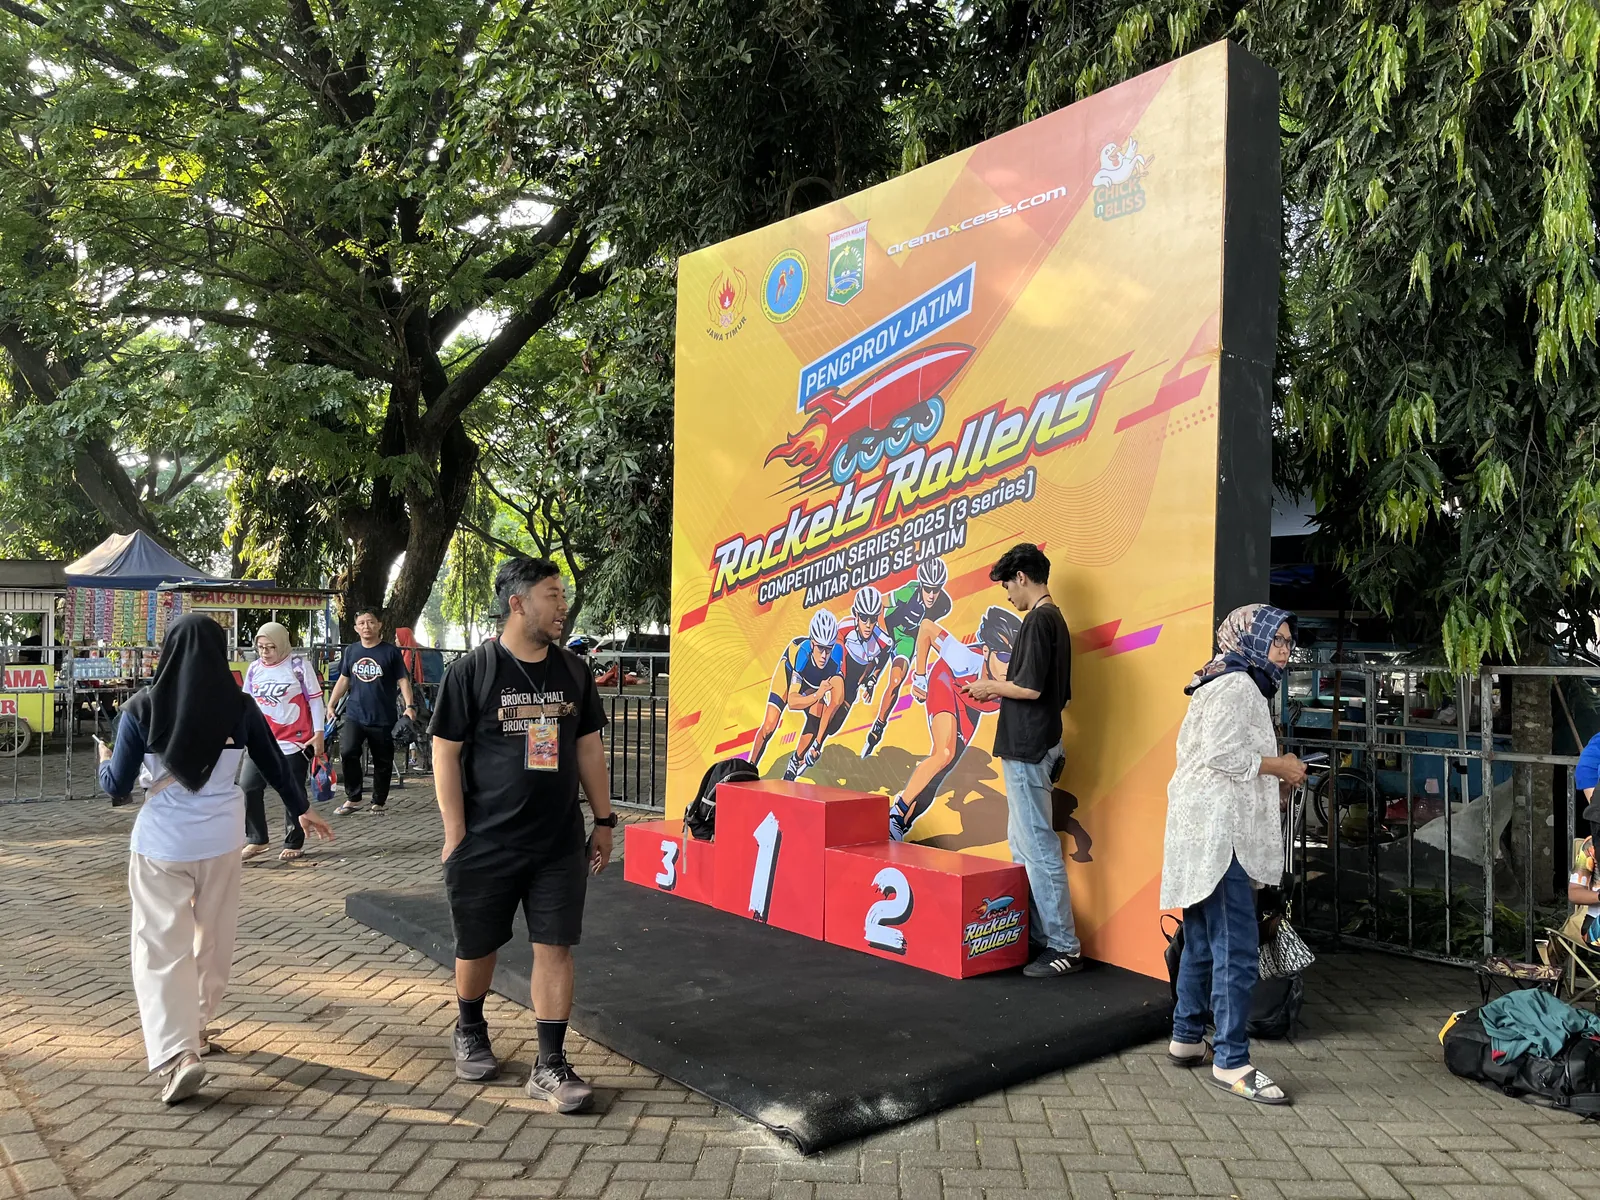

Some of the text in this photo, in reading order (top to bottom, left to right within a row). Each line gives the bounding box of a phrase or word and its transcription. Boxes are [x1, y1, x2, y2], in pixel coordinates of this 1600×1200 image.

[1096, 180, 1138, 202] CHICK
[1105, 194, 1143, 217] BLISS
[886, 186, 1067, 256] aremaxcess.com
[706, 316, 747, 341] JAWA TIMUR
[805, 282, 964, 397] PENGPROV JATIM
[713, 370, 1108, 593] Rockets Rollers
[759, 551, 846, 603] COMPETITION
[847, 529, 900, 566] SERIES
[903, 508, 946, 543] 2025
[804, 524, 965, 608] ANTAR CLUB SE JATIM
[352, 662, 383, 676] ASABA
[501, 691, 564, 706] BROKEN ASPHALT
[502, 706, 519, 719] NOT
[655, 840, 678, 888] 3
[749, 811, 780, 919] 1
[864, 867, 911, 951] 2
[964, 911, 1020, 942] Rockets
[969, 926, 1022, 956] Rollers
